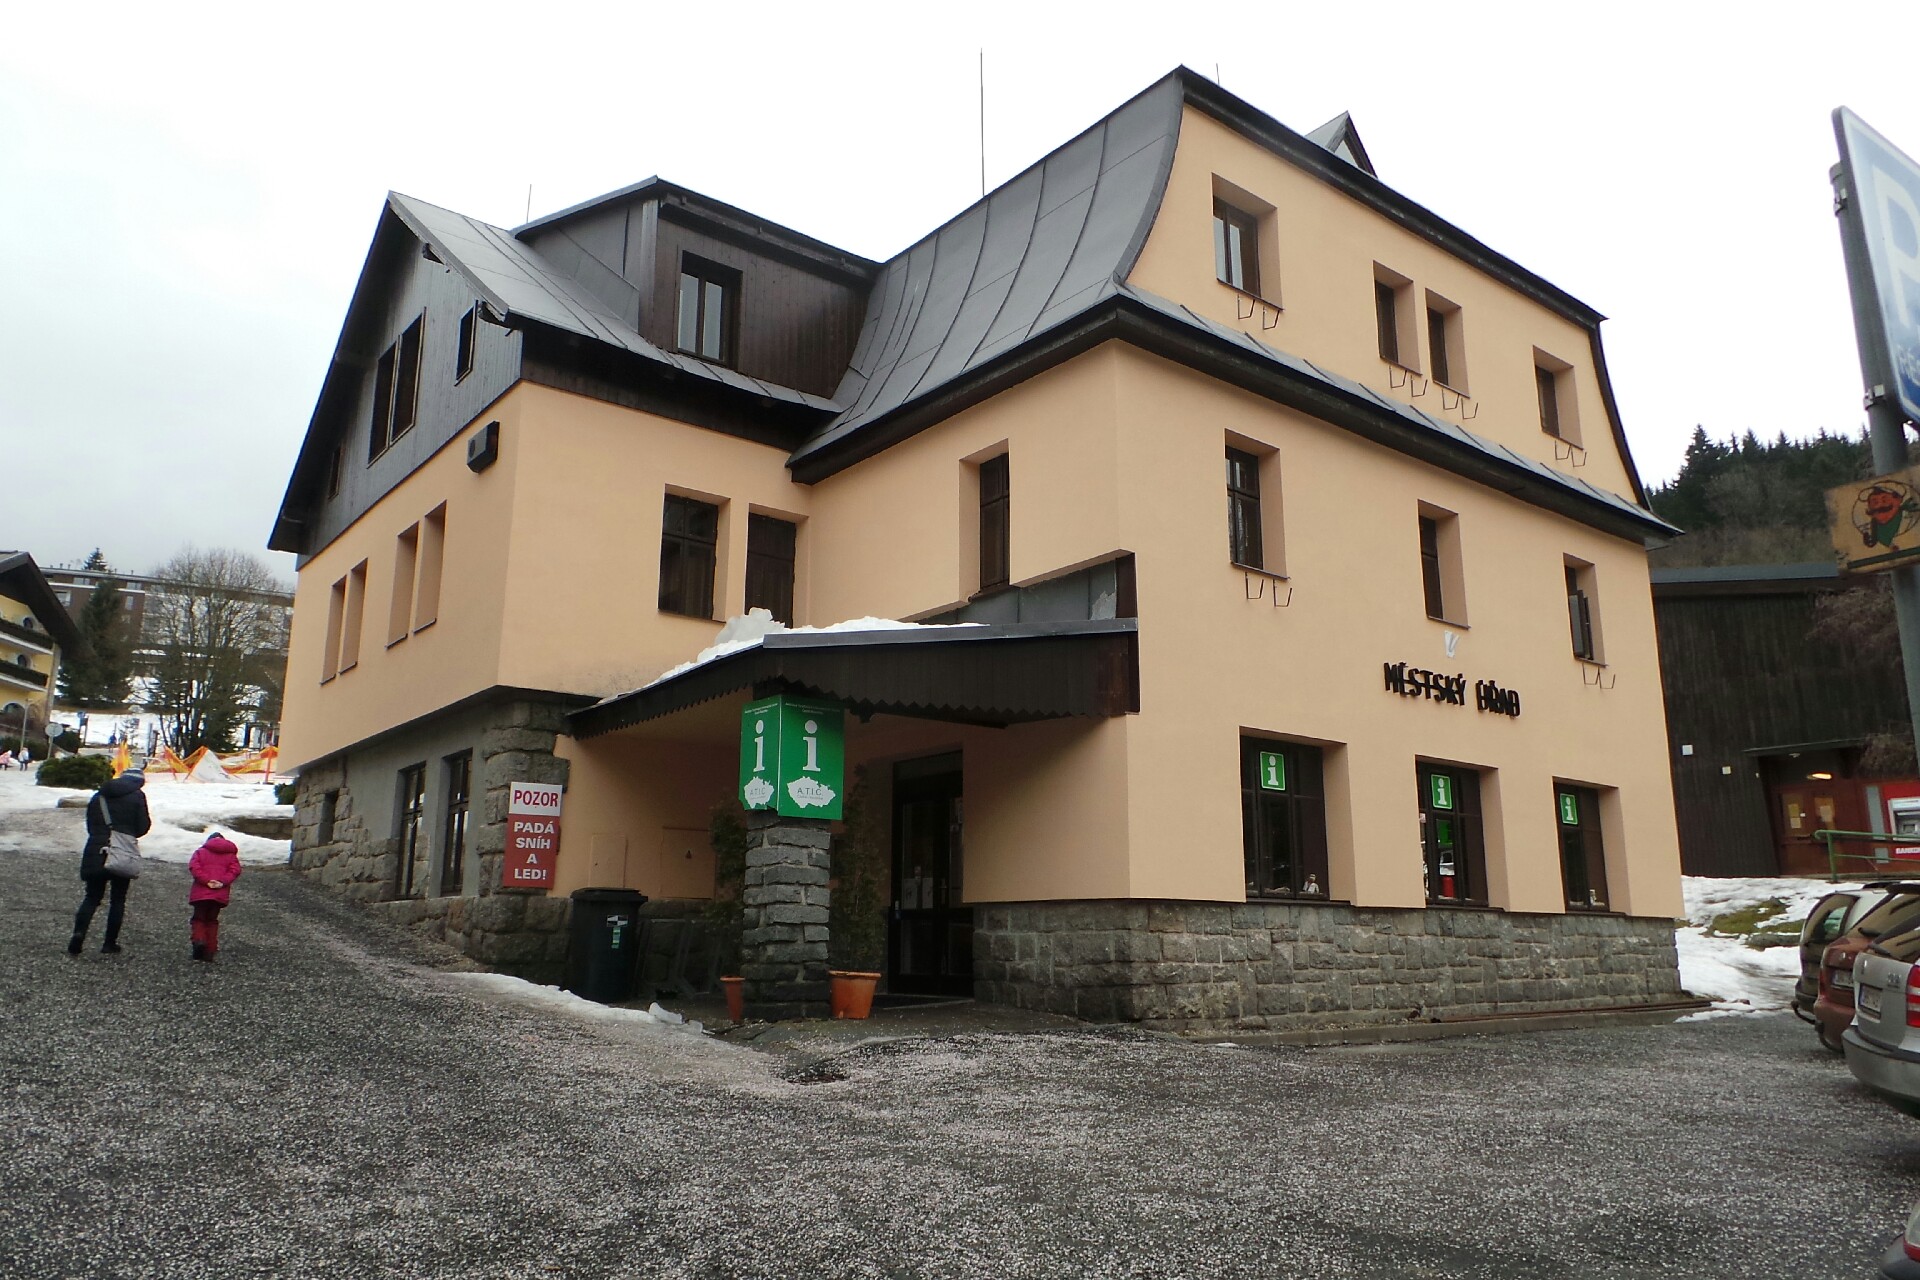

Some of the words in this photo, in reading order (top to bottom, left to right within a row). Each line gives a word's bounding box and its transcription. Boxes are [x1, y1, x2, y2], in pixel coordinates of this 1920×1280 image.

[1384, 661, 1466, 706] MĚSTSKÝ
[1475, 679, 1520, 718] ÚŘAD
[802, 719, 820, 772] i
[513, 789, 559, 807] POZOR
[513, 821, 555, 834] PADÁ
[515, 836, 551, 849] SNÍH
[526, 853, 538, 864] A
[514, 868, 547, 880] LED!
